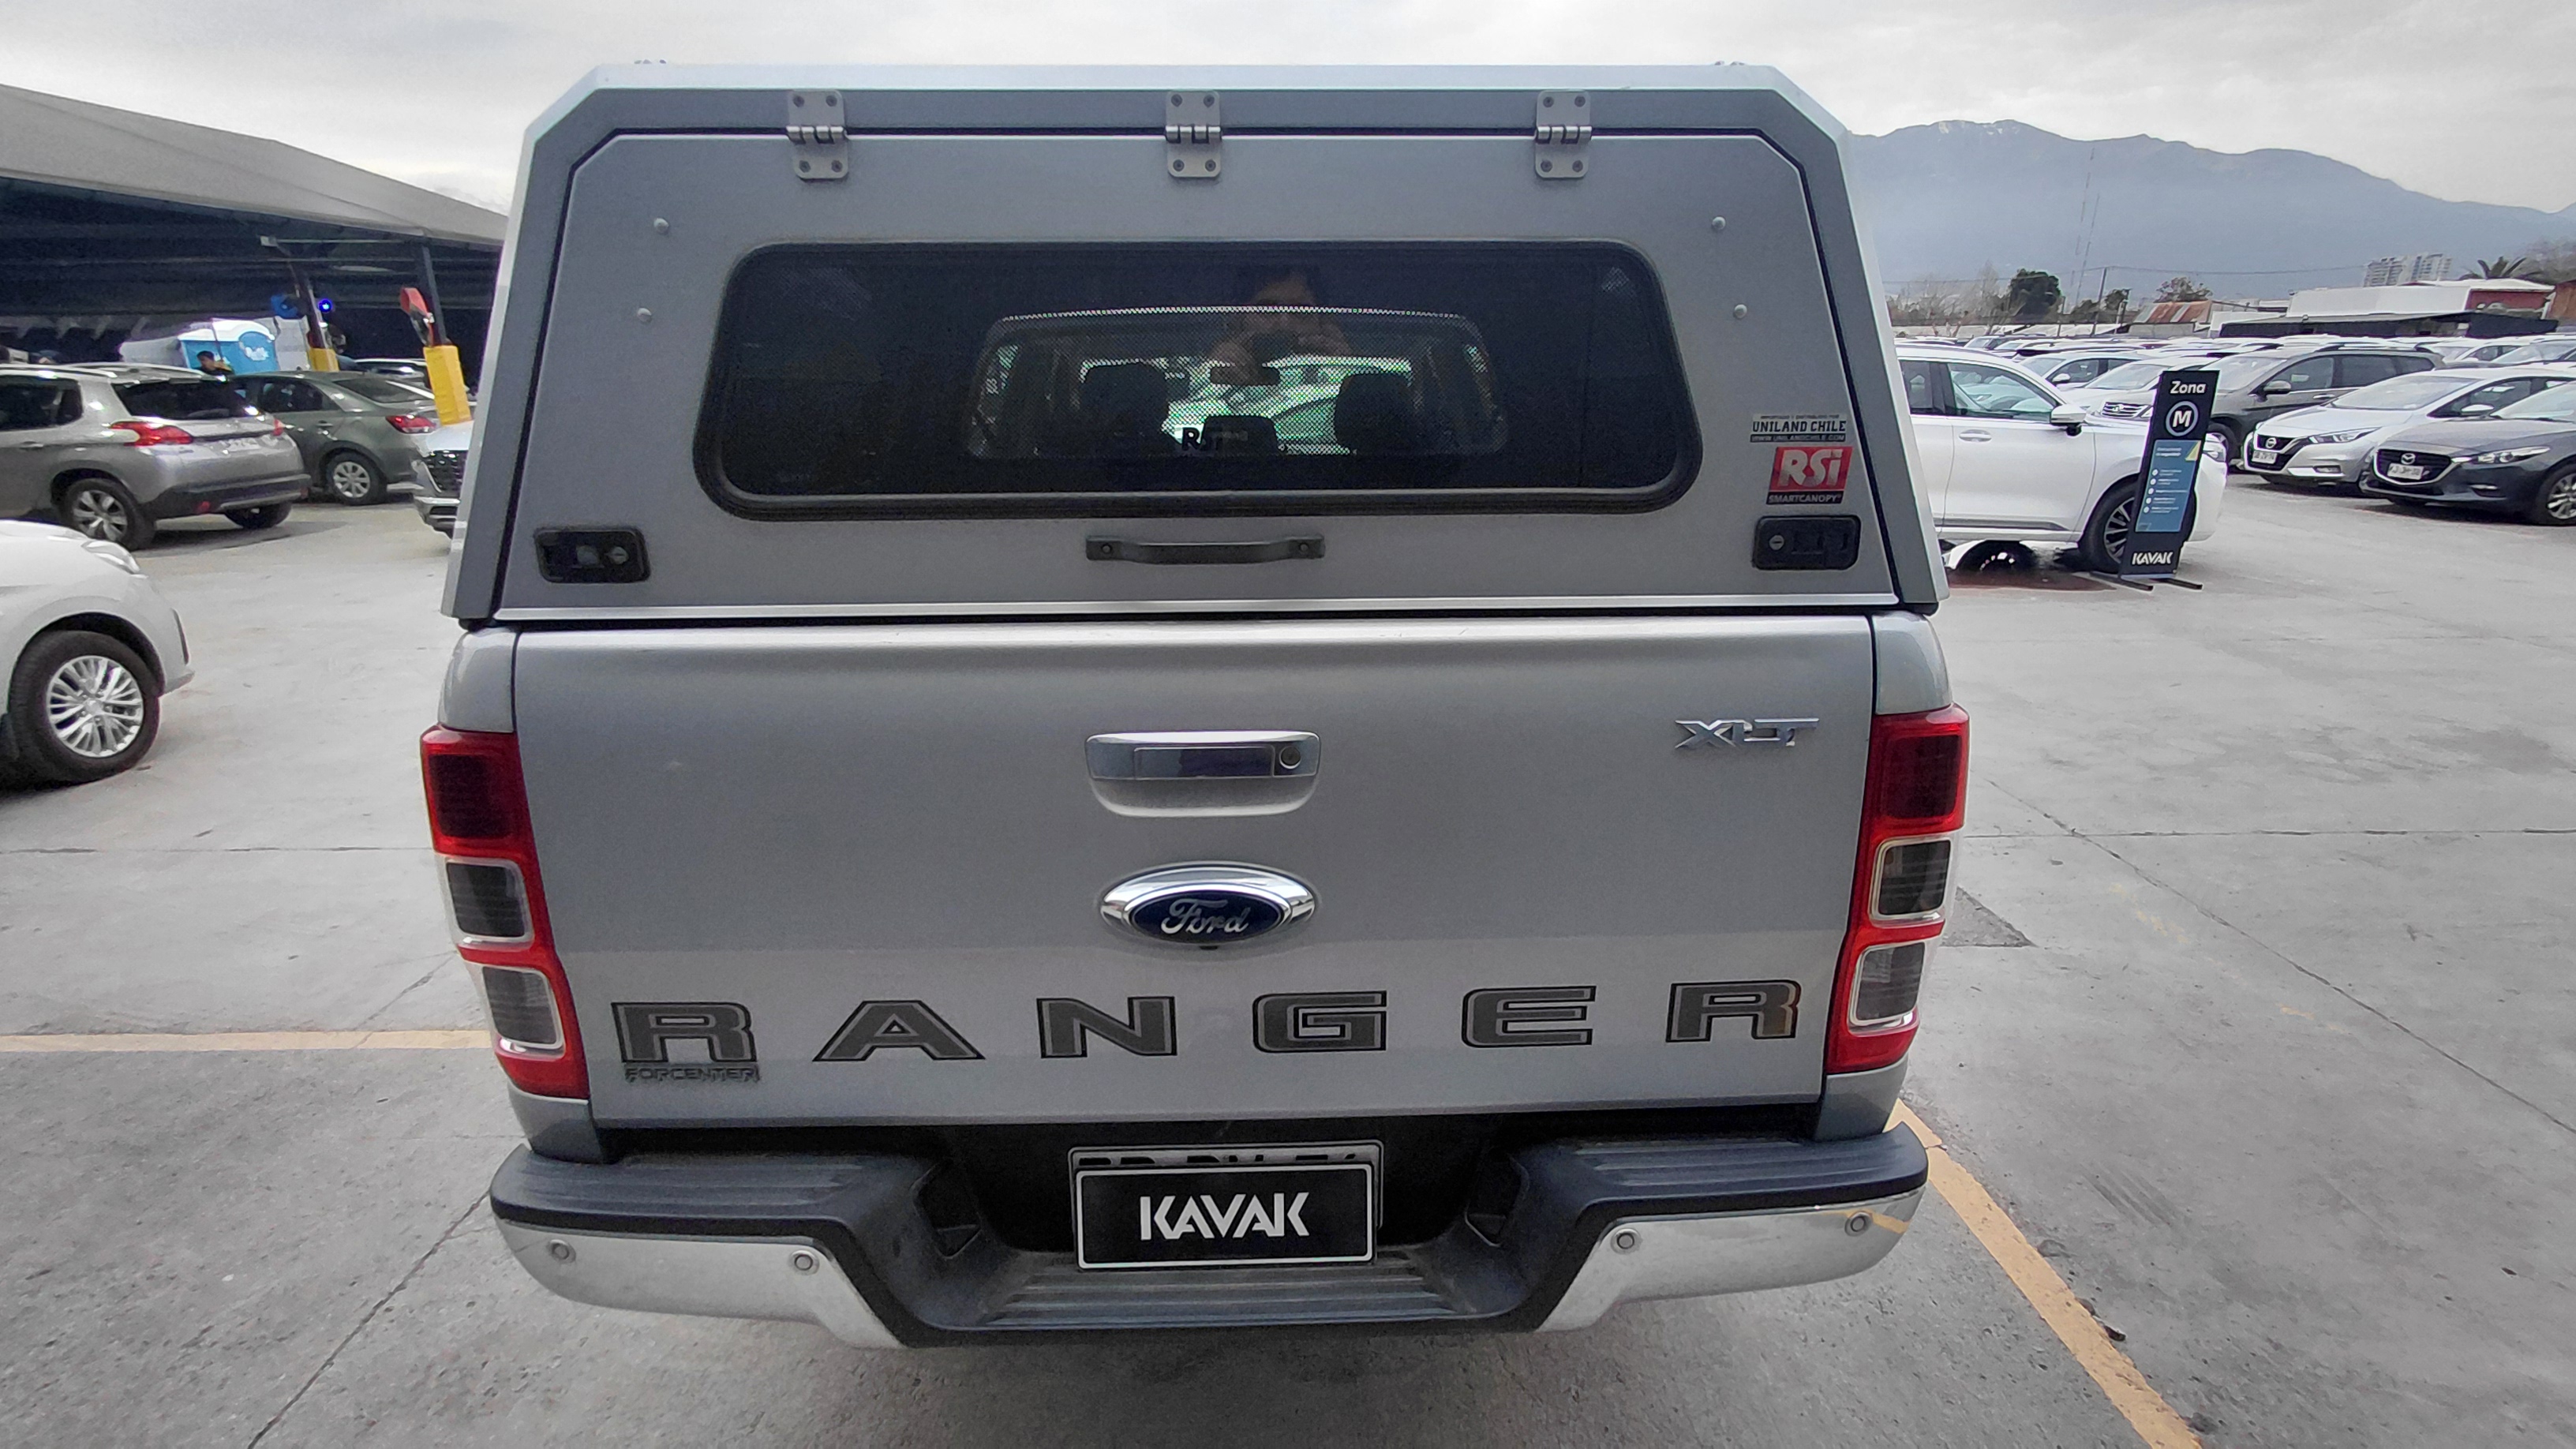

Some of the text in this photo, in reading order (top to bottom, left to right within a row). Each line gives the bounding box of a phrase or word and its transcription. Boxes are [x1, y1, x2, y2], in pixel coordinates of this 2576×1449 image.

[2170, 380, 2206, 395] Zona
[1752, 420, 1847, 432] UNILAND CHILE
[2172, 410, 2192, 428] M
[2132, 551, 2174, 566] KAVAK
[1674, 717, 1820, 750] XLT
[1160, 897, 1250, 934] Ford
[610, 979, 1801, 1062] RANGER
[624, 1065, 761, 1083] FORCENTER
[1140, 1192, 1310, 1241] KAVAK
